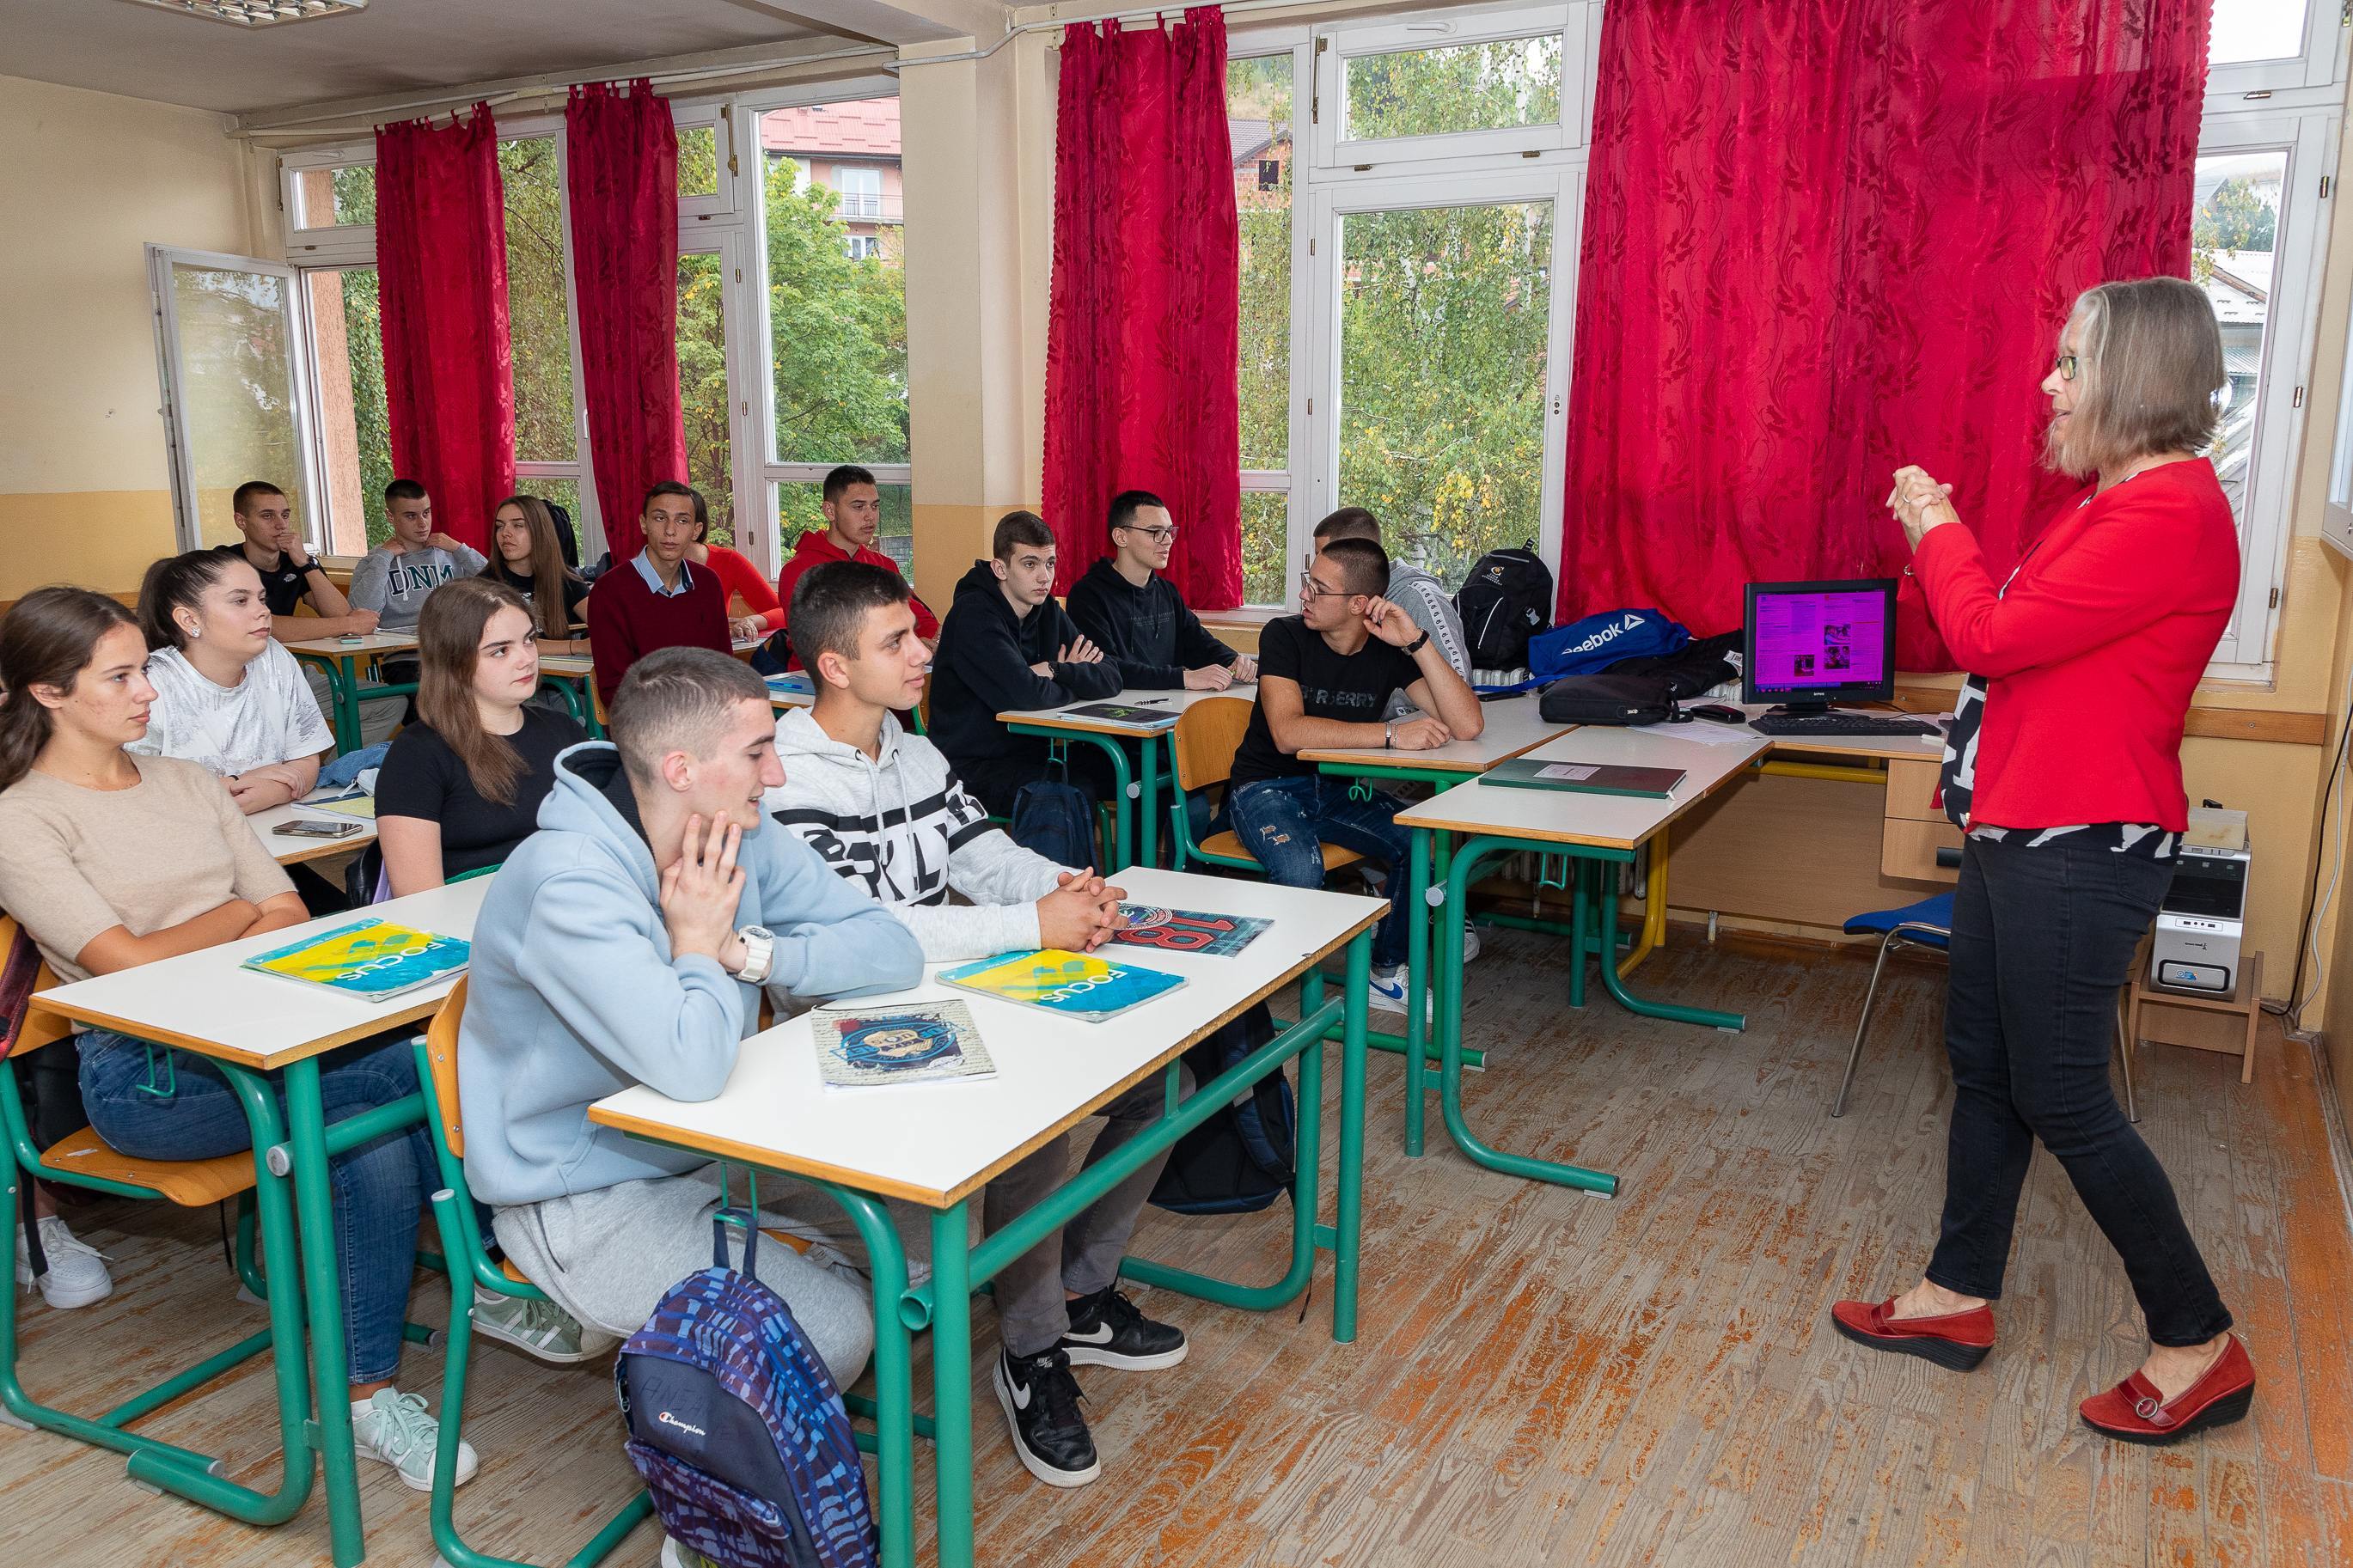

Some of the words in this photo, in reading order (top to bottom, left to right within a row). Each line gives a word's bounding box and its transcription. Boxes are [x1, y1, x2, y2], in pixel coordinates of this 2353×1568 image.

[1301, 686, 1376, 707] RERRY
[336, 942, 447, 981] FOCUS
[1039, 968, 1128, 1003] FOCUS
[658, 1411, 706, 1437] Champion
